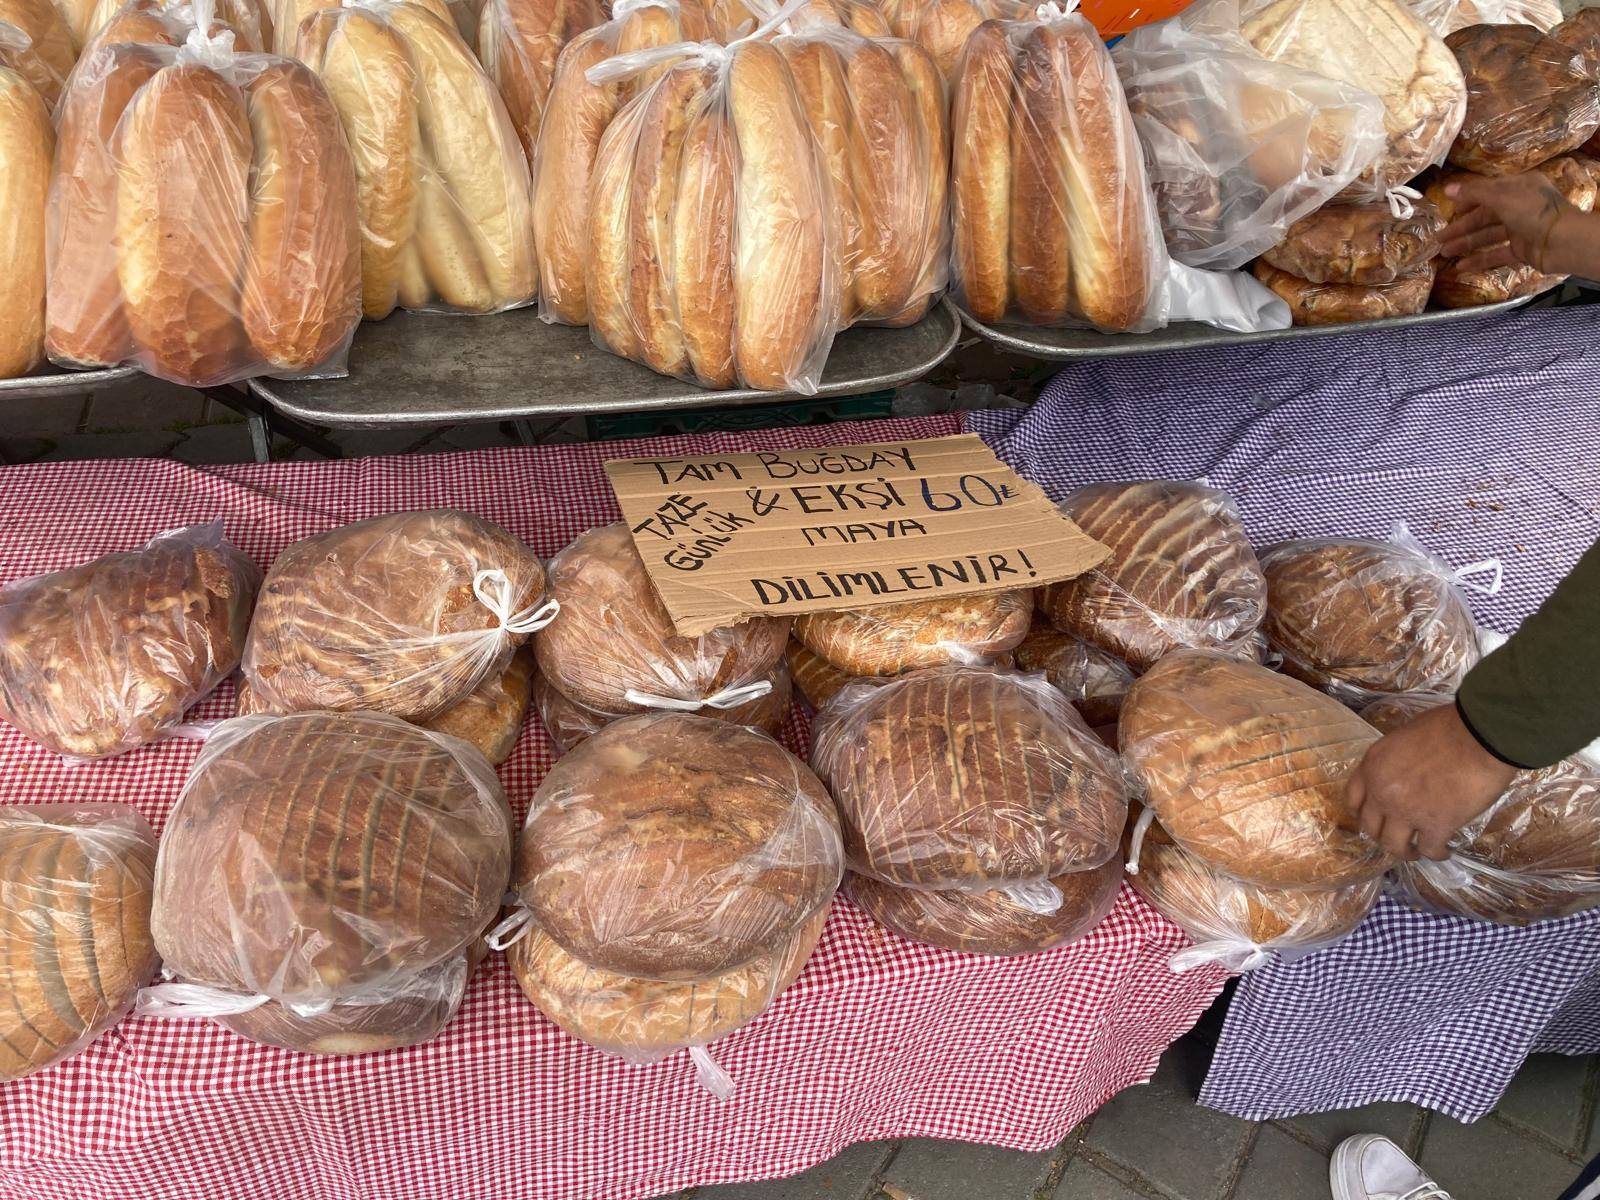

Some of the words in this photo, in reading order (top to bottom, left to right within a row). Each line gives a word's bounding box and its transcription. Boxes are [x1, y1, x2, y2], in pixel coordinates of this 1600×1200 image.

[633, 460, 743, 485] TAM
[756, 447, 917, 479] BUĞDAY
[632, 492, 709, 541] TAZE
[745, 486, 790, 517] &
[790, 477, 906, 514] EKŞİ
[801, 518, 928, 546] MAYA
[750, 548, 1038, 606] DİLİMLENİR!
